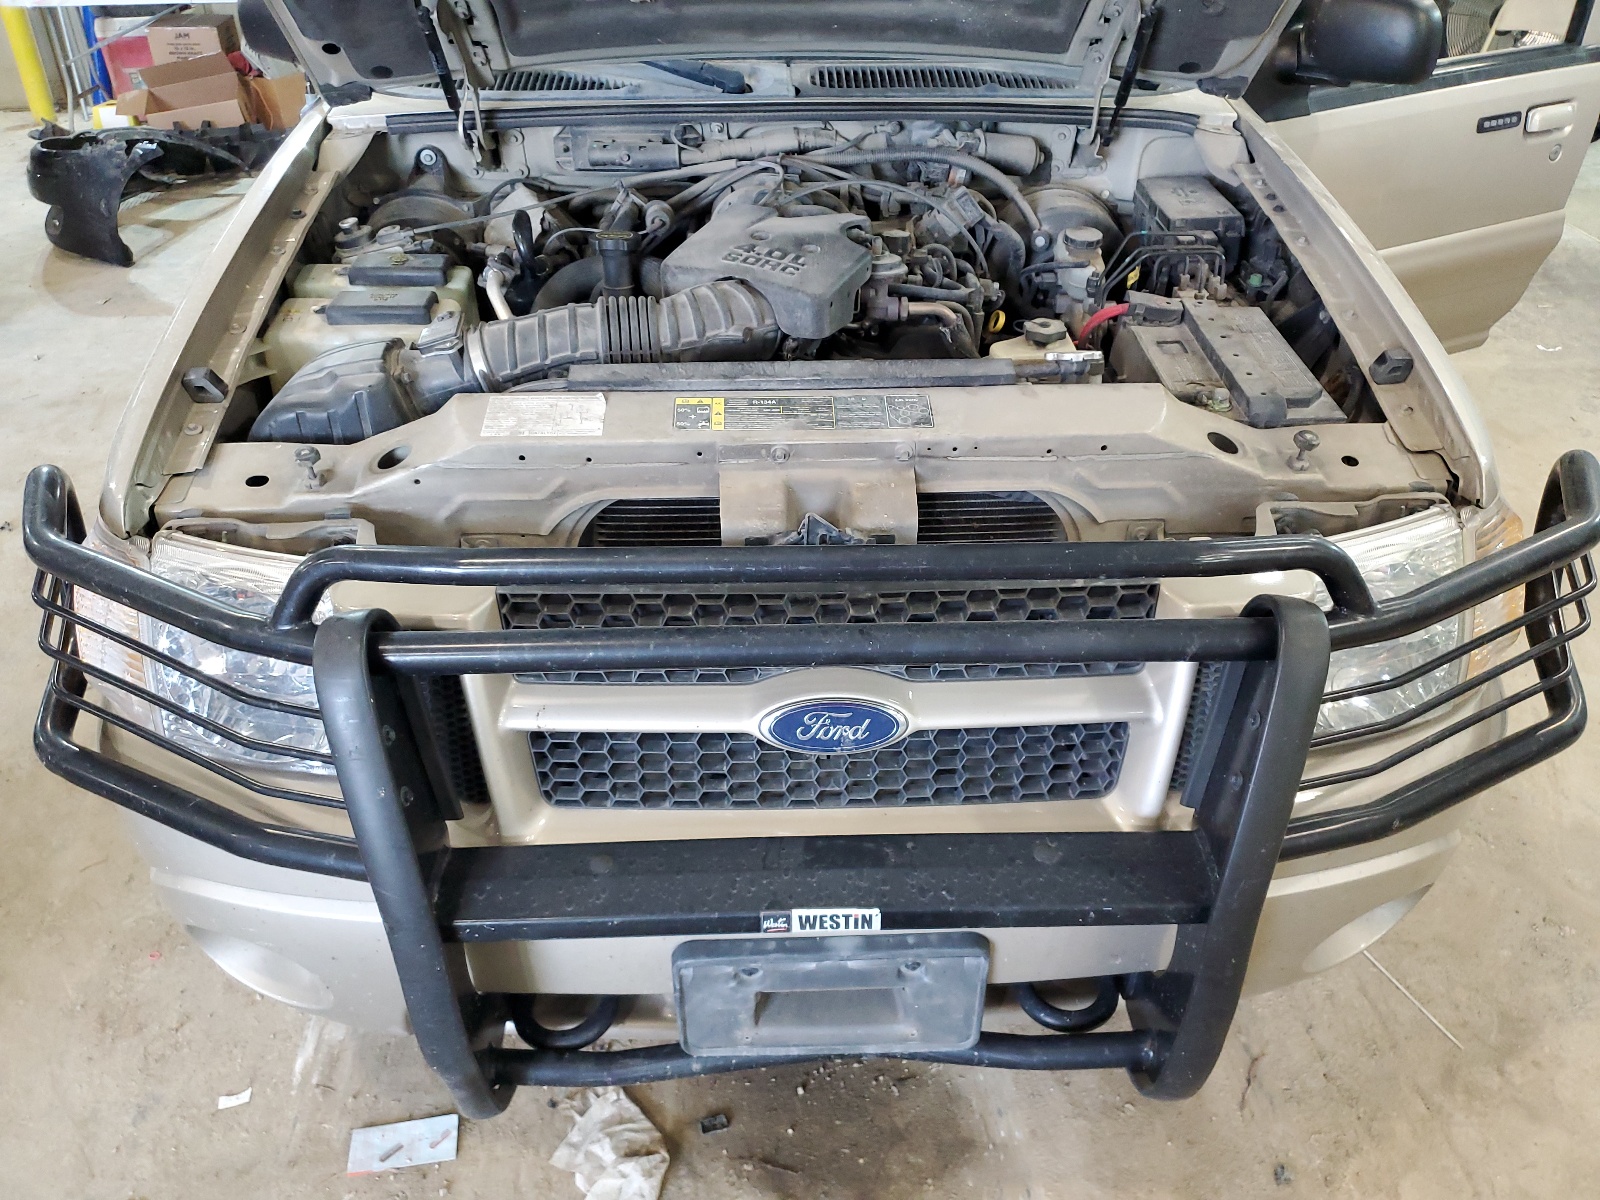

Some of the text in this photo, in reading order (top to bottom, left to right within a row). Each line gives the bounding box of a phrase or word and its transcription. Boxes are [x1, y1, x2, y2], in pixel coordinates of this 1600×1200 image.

[721, 251, 800, 275] SOHC
[732, 243, 806, 267] 4.0L
[796, 711, 872, 740] Ford
[798, 913, 873, 930] WESTIN
